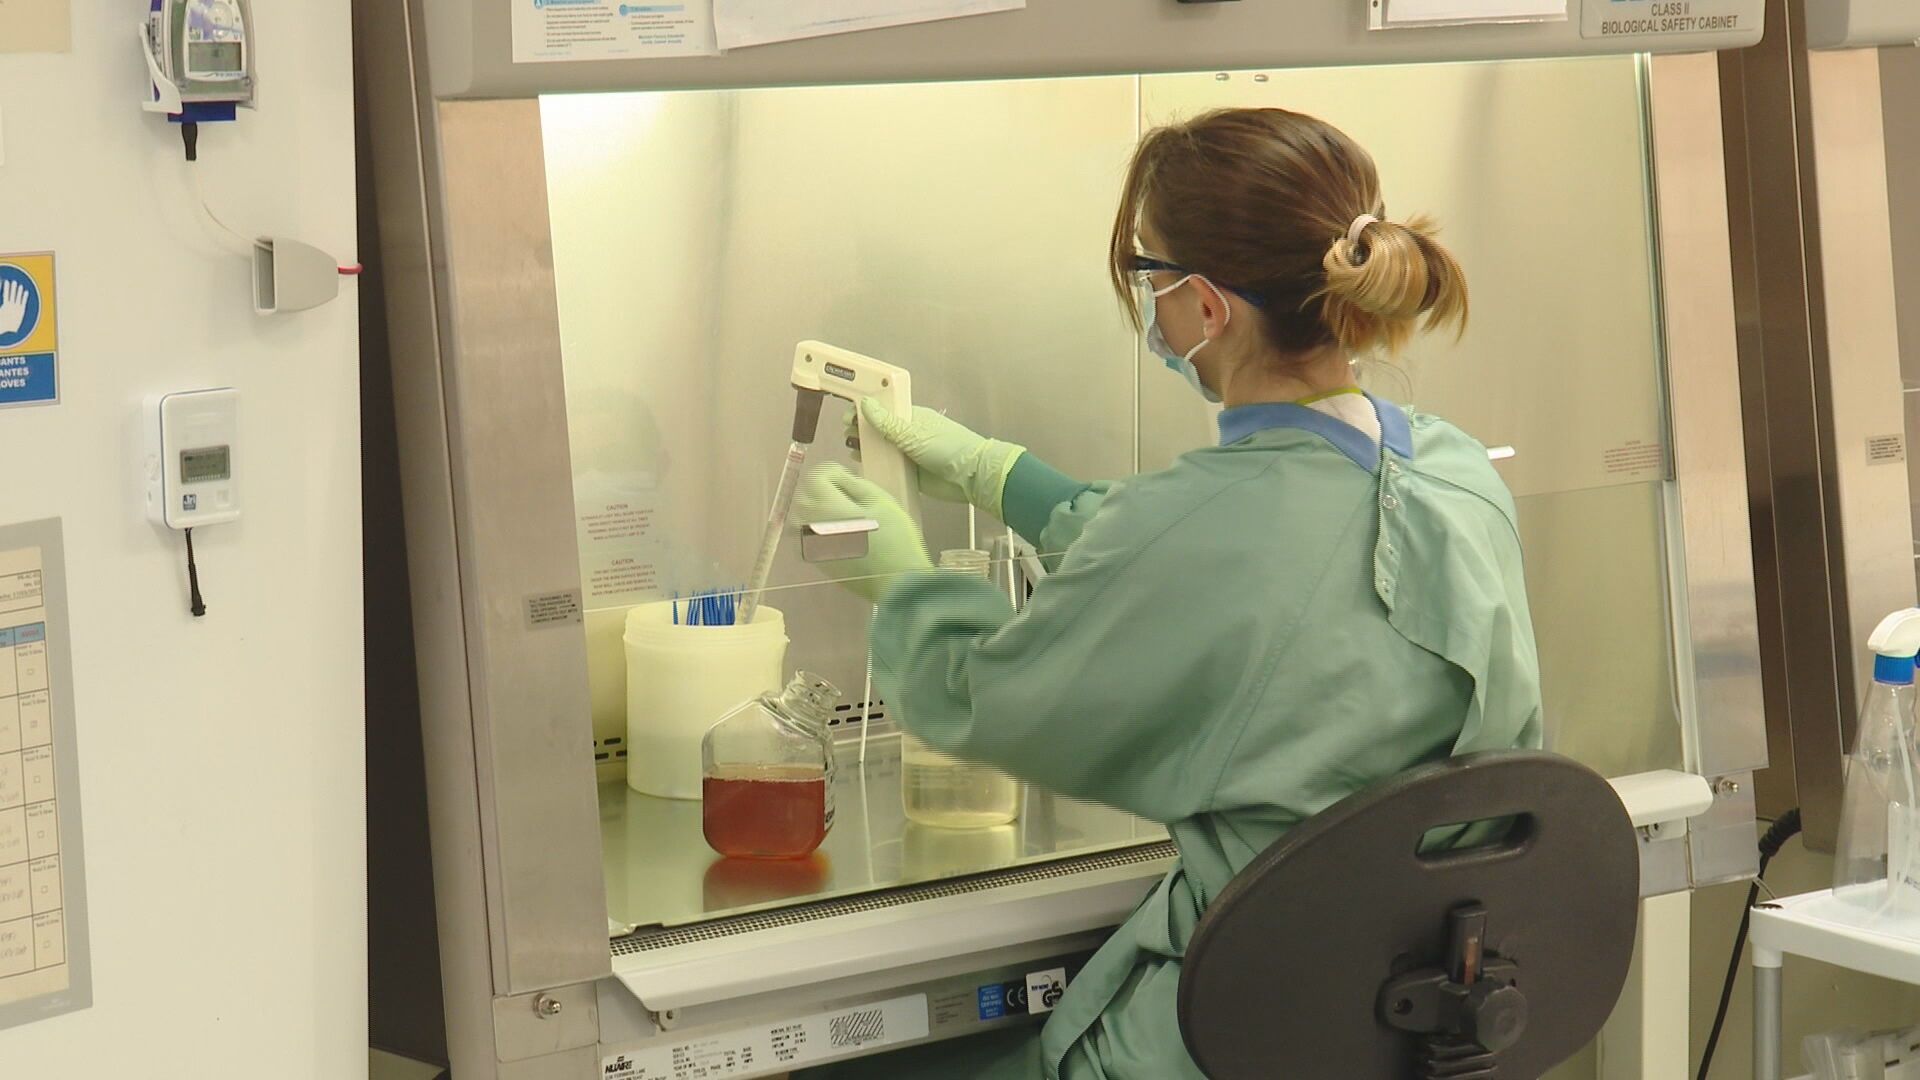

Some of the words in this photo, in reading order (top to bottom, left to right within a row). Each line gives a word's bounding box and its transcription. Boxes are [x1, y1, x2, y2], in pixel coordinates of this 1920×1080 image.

[1651, 3, 1681, 16] CLASS
[1684, 2, 1690, 14] II
[1602, 20, 1658, 34] BIOLOGICAL
[1661, 18, 1696, 32] SAFETY
[1698, 15, 1738, 29] CABINET
[0, 357, 26, 366] ANTS
[0, 378, 26, 388] OVES
